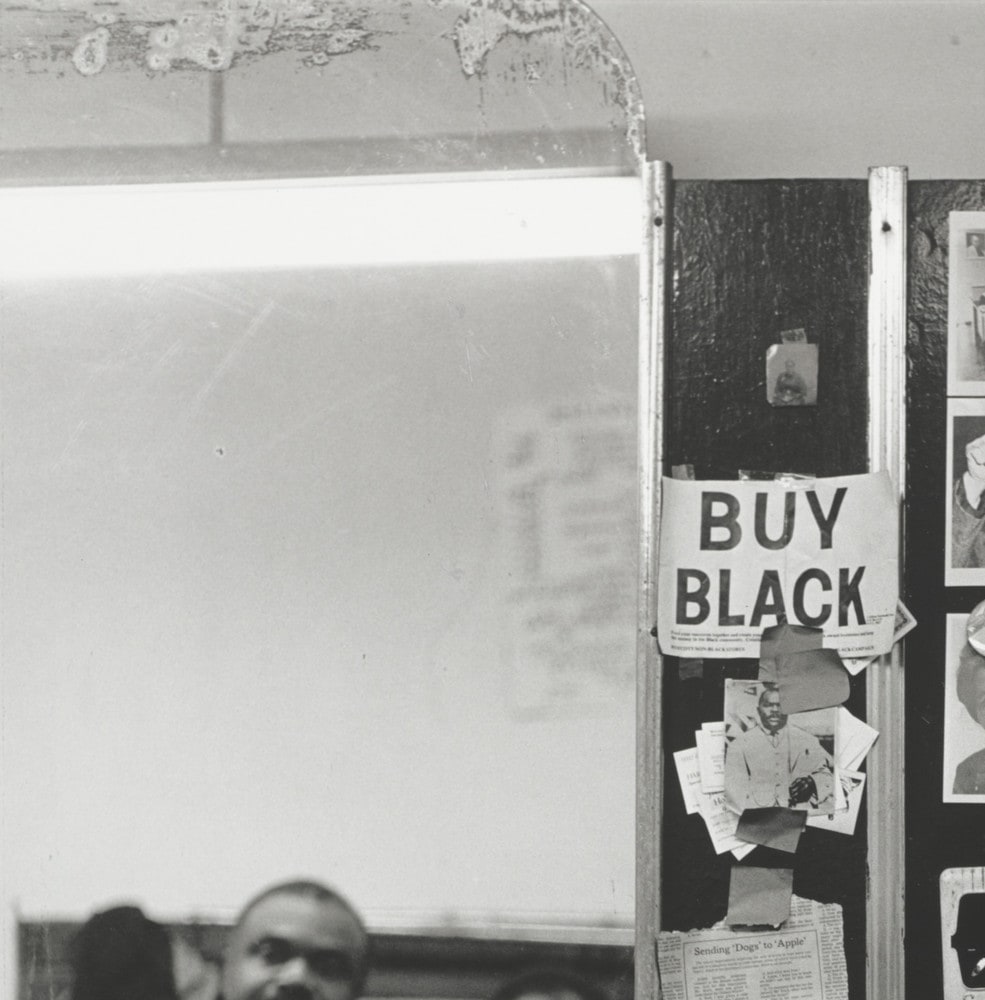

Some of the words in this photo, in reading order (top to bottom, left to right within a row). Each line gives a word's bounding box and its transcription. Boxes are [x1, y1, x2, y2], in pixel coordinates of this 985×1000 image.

[700, 487, 848, 551] BUY
[676, 566, 866, 627] BLACK
[694, 945, 731, 956] Sending
